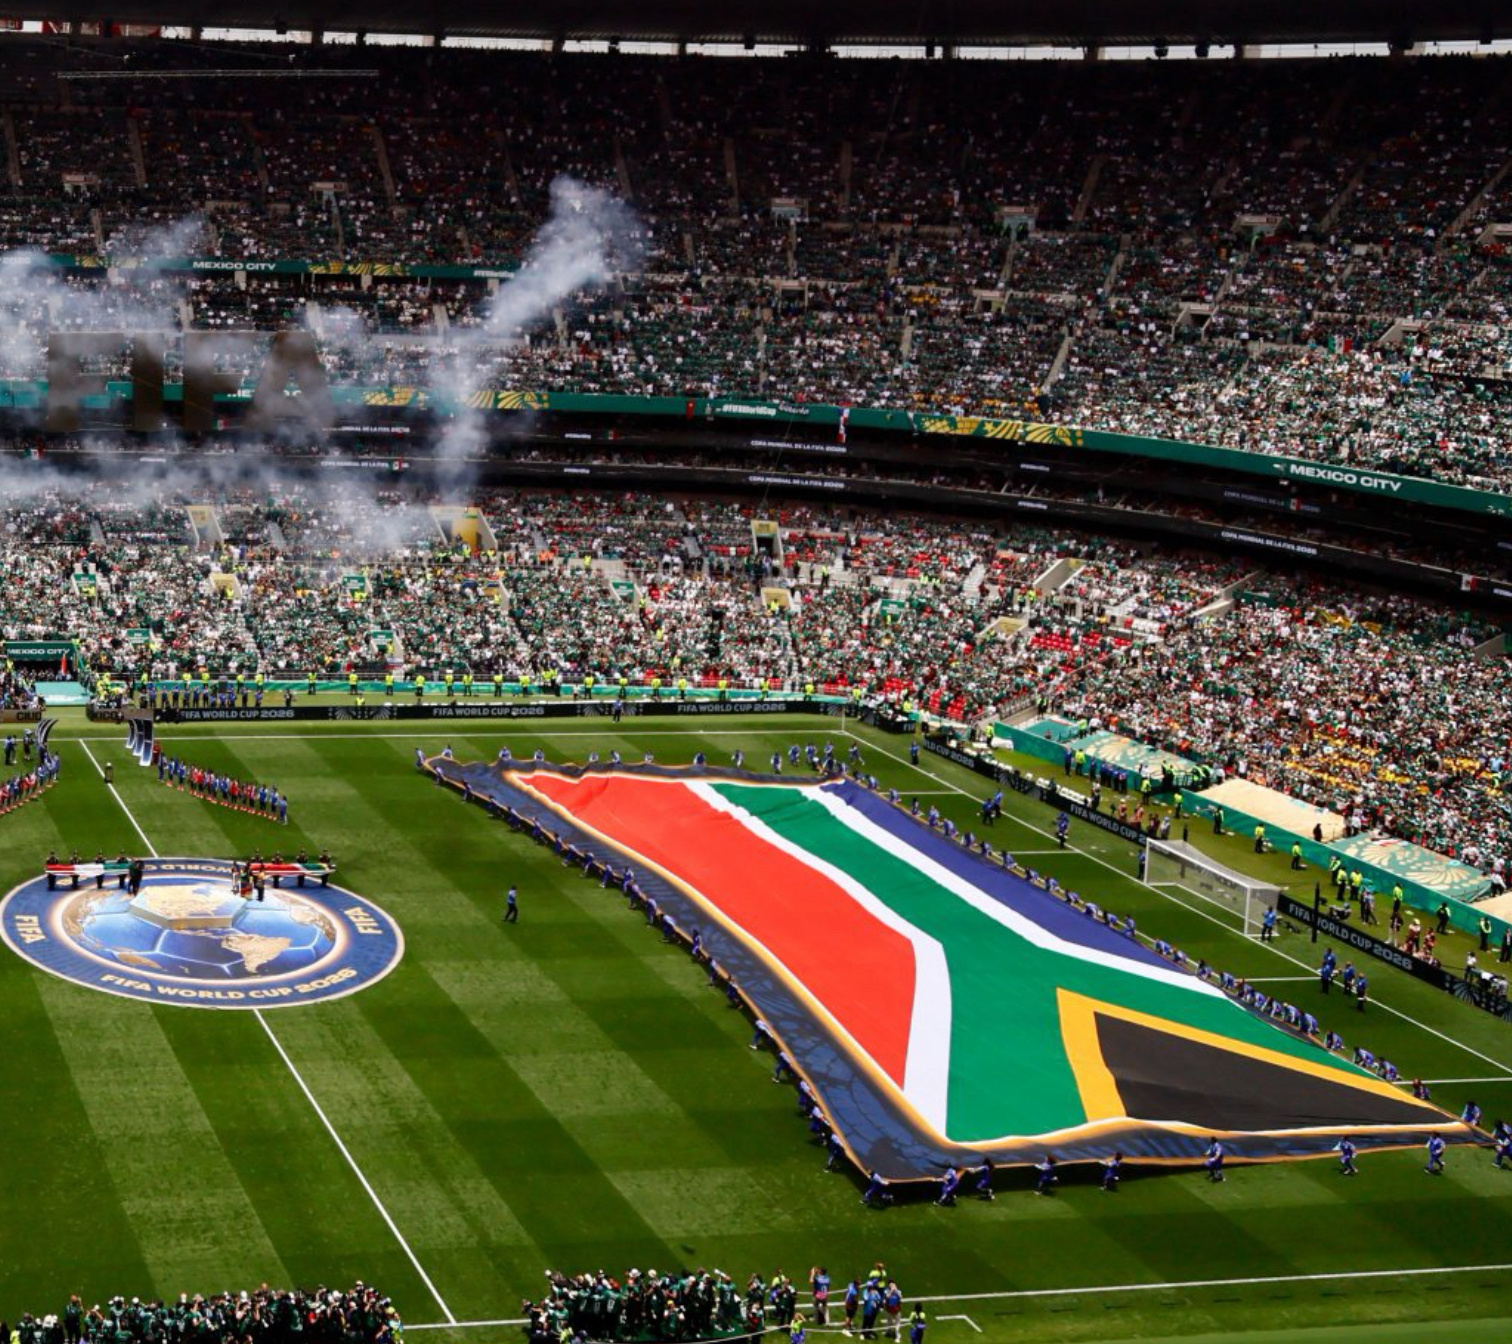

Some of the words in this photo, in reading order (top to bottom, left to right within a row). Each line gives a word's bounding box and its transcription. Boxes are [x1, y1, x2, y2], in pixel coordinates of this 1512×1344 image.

[192, 261, 244, 270] MEXICO
[245, 263, 277, 271] CITY
[1289, 463, 1358, 485] MEXICO
[1360, 475, 1402, 492] CITY
[181, 710, 202, 719] FIFA
[202, 710, 238, 719] WORLD
[239, 710, 259, 719] CUP
[259, 710, 295, 719] 2026
[433, 708, 454, 716] FIFA
[455, 708, 490, 716] WORLD
[491, 708, 510, 716] CUP
[511, 708, 545, 716] 2026
[677, 703, 699, 712] FIFA
[699, 703, 732, 712] WORLD
[733, 703, 753, 712] CUP
[753, 703, 787, 712] 2026
[1070, 803, 1088, 818] FIFA
[1088, 812, 1119, 832] WORLD
[1120, 826, 1137, 839] CUP
[14, 914, 46, 944] FIFA
[343, 905, 382, 936] FIFA
[1289, 902, 1310, 922] FIFA
[1350, 933, 1372, 950] CUP
[1373, 943, 1414, 970] 2026
[99, 972, 151, 993] FIFA
[156, 985, 245, 1000] WORLD
[249, 982, 291, 999] CUP
[293, 967, 358, 993] 2026
